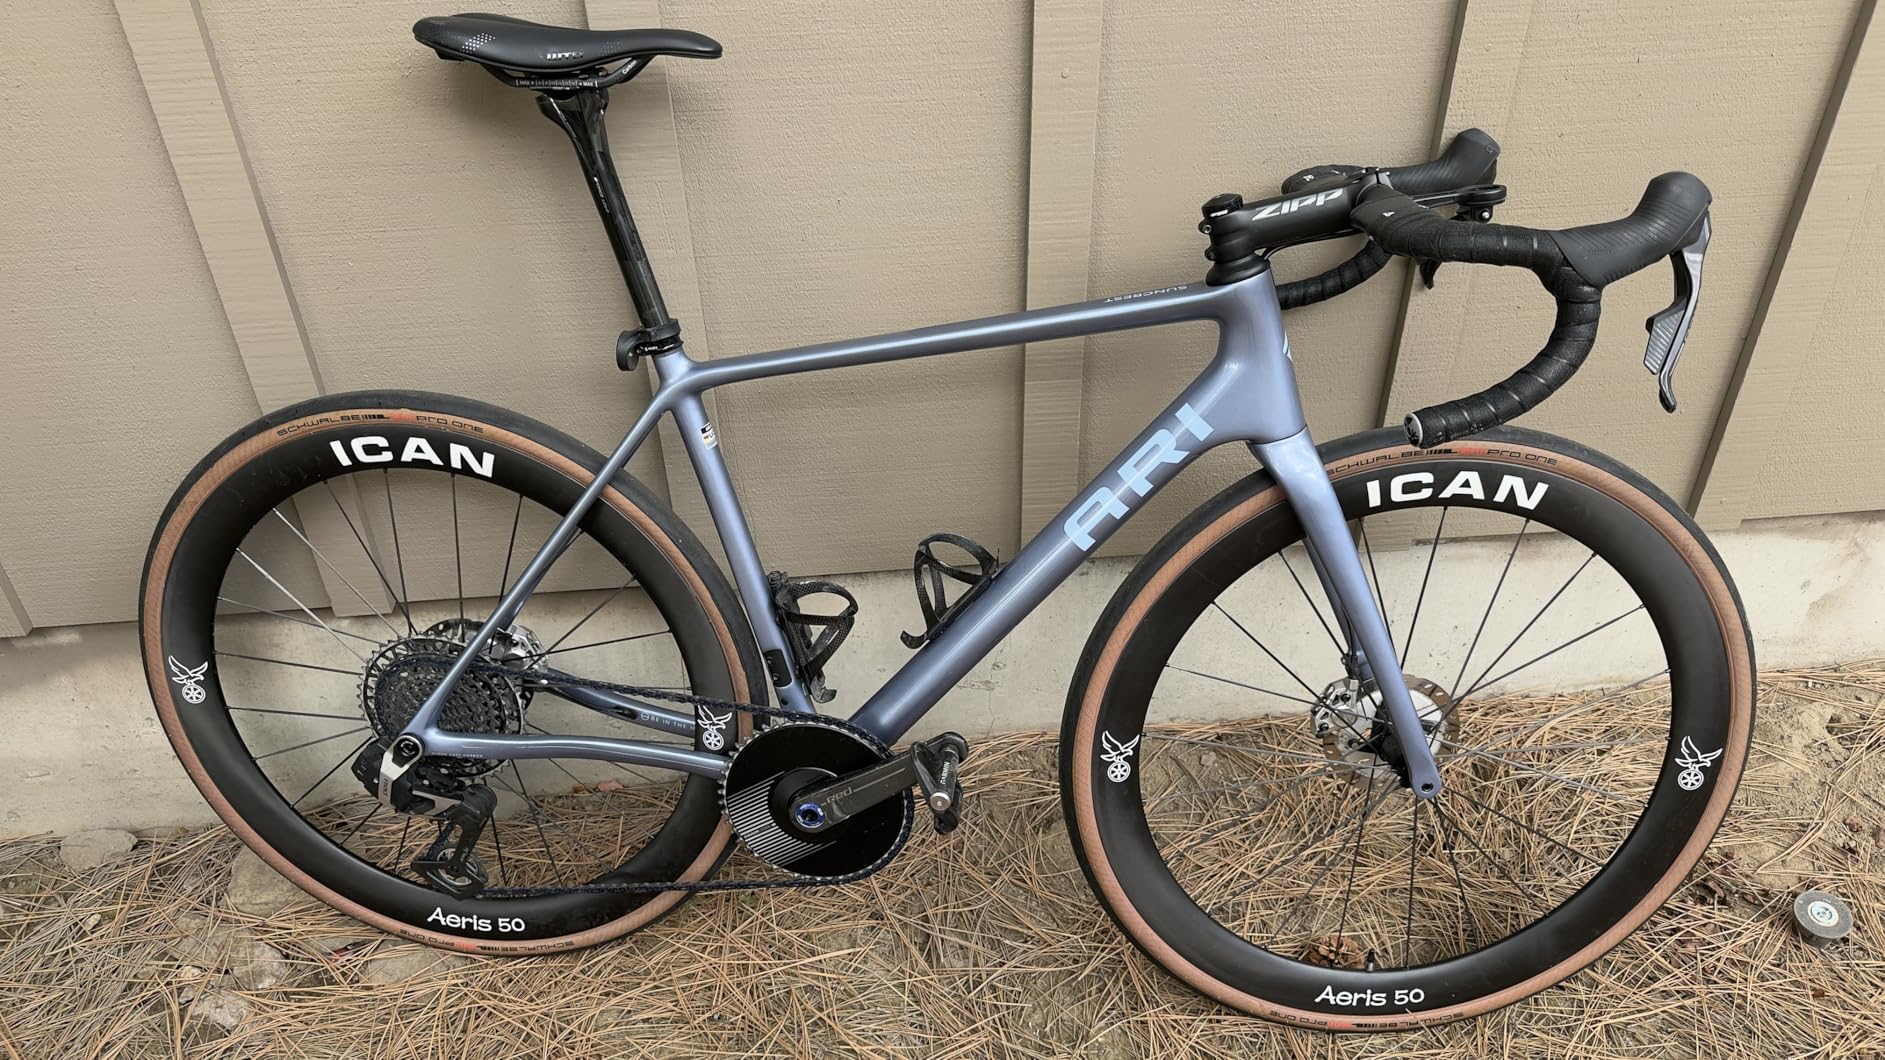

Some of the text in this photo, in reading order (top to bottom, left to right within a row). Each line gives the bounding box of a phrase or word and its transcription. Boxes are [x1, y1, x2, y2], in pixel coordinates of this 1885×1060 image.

[1252, 188, 1344, 221] ZIPP
[1104, 285, 1188, 303] SUNCREST
[277, 414, 360, 437] SCHWALBE
[329, 436, 495, 478] ICAN
[1327, 450, 1426, 475] SCHWALBE
[1064, 402, 1214, 551] ARI
[1366, 470, 1549, 511] ICAN
[673, 721, 686, 729] THE
[427, 907, 526, 932] Aeris 50
[502, 940, 575, 952] SCHWALBE
[1314, 985, 1425, 1007] Aeris 50
[1378, 1011, 1464, 1028] SCHWALBE
